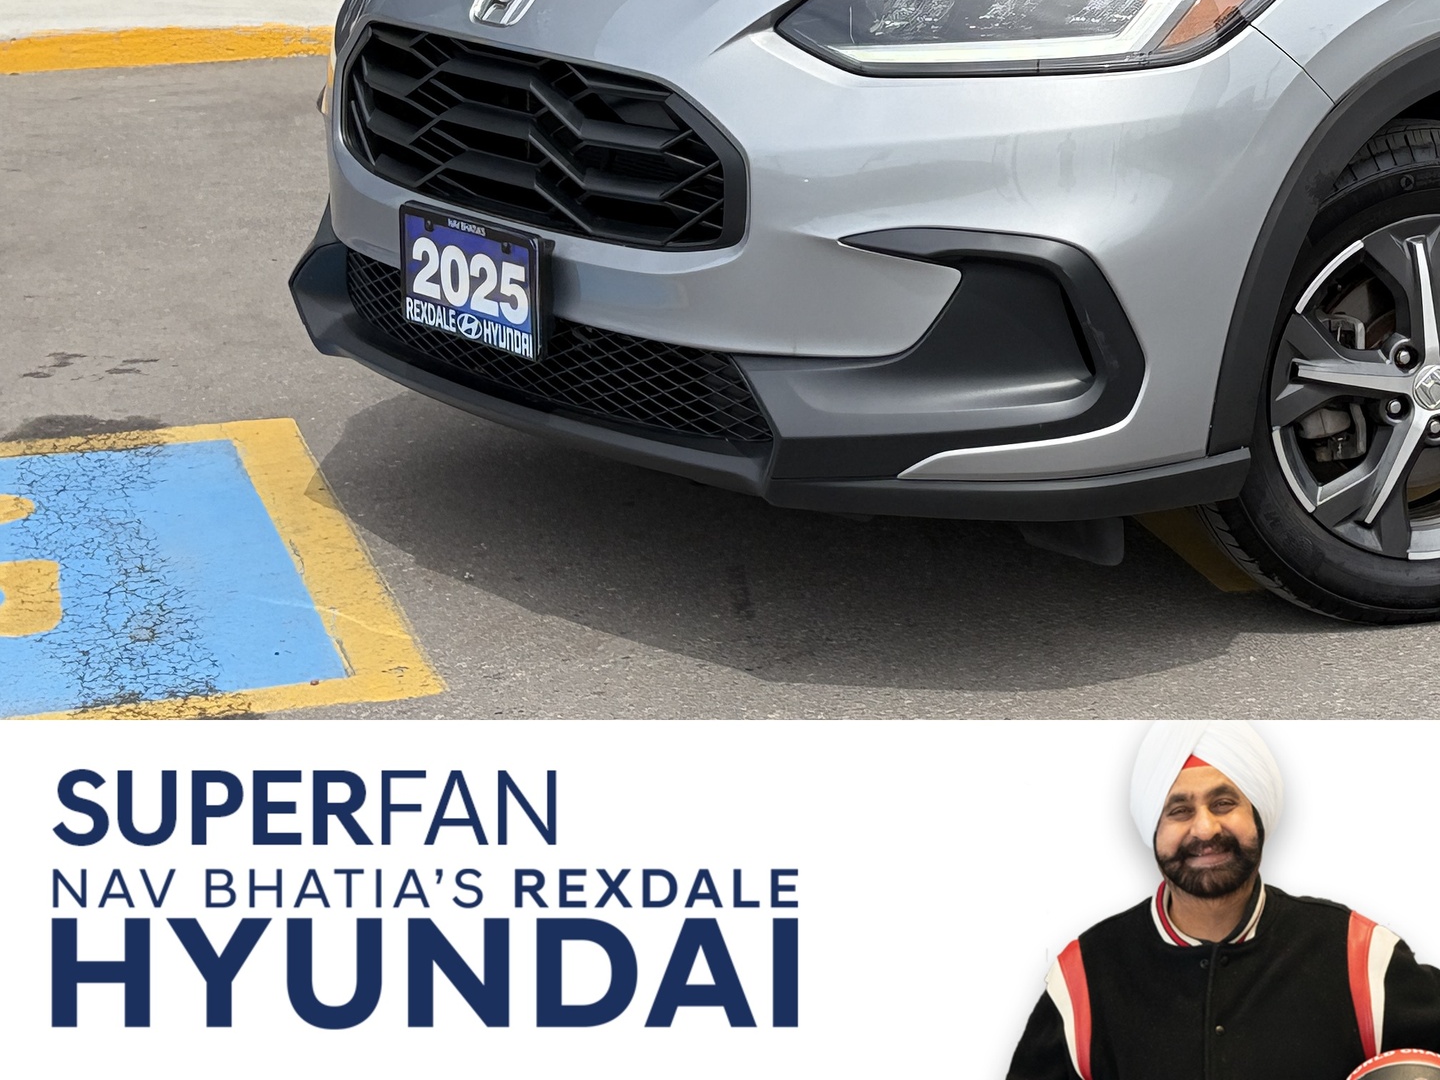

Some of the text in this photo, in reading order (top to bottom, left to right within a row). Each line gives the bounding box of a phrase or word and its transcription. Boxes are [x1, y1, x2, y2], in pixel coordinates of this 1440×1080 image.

[412, 236, 529, 325] 2025
[405, 296, 533, 359] REXDALE HYUNDAI
